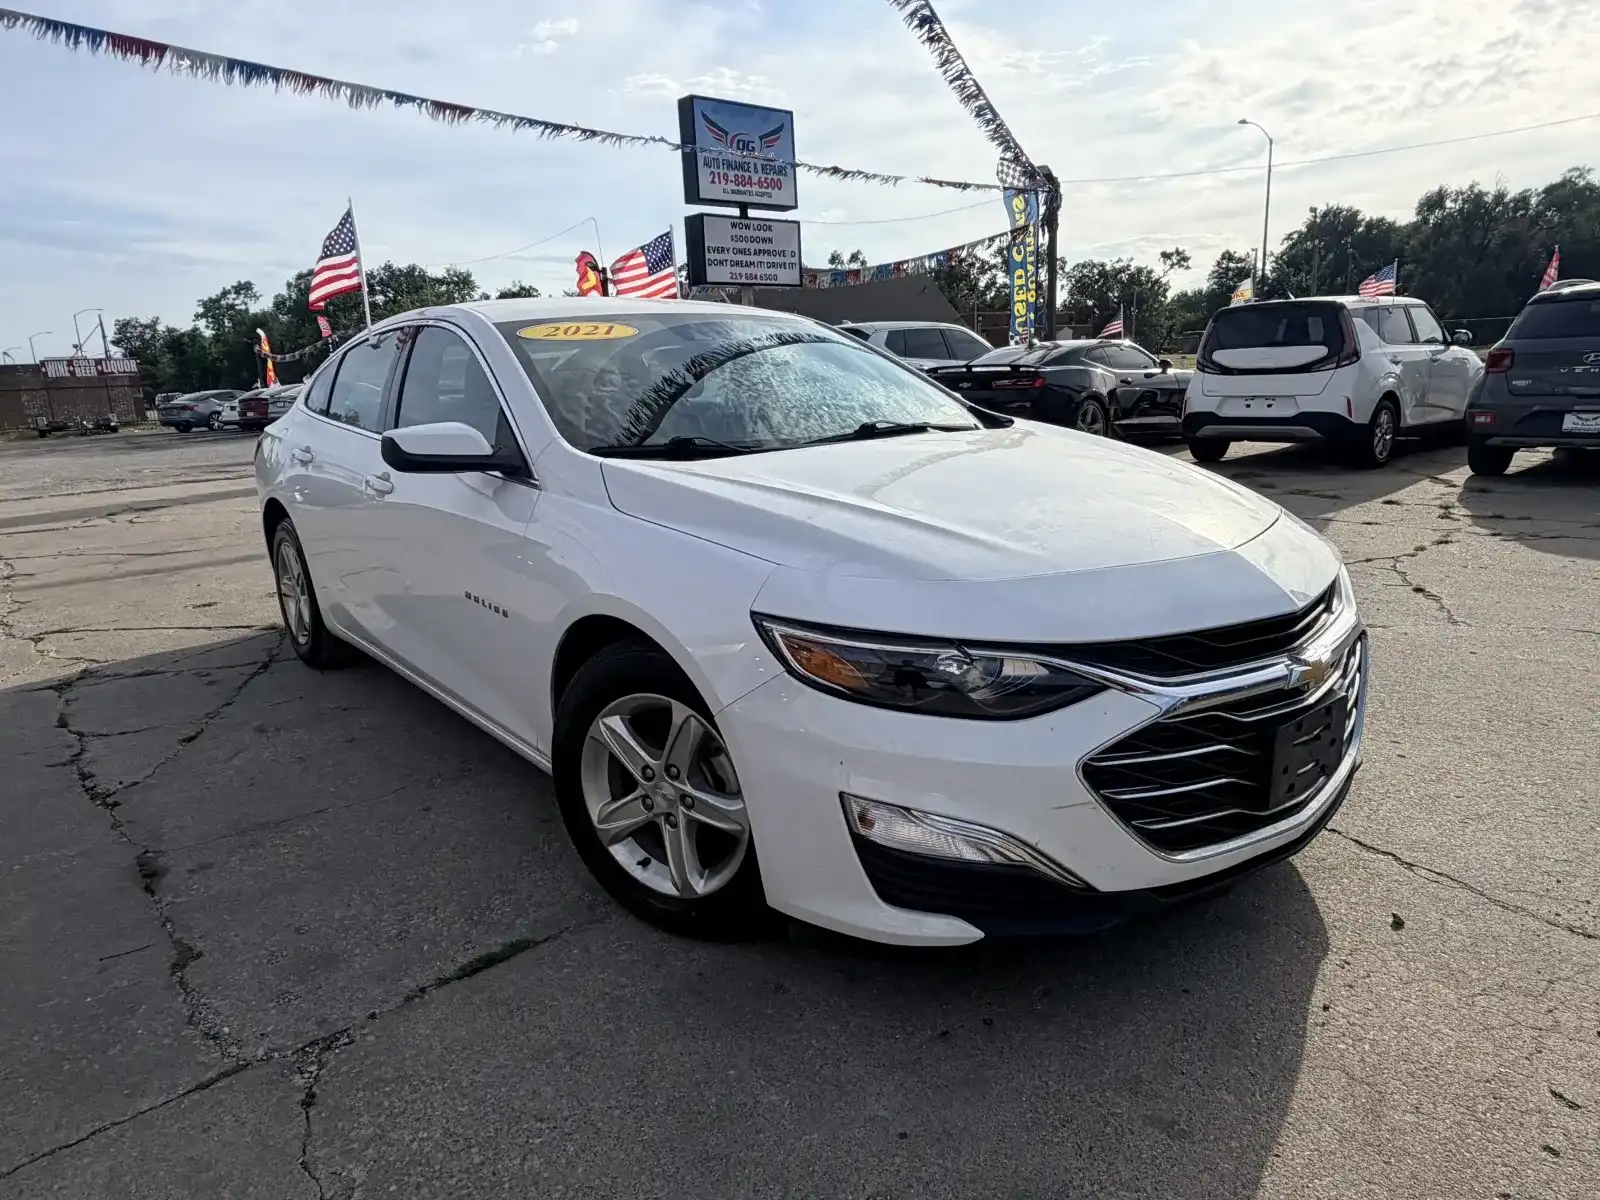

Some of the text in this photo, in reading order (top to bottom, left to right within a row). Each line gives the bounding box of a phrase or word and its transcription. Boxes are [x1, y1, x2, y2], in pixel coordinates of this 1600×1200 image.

[703, 155, 788, 177] AUTO FINANCE & REPAIRS
[709, 171, 783, 191] 219-884-6500
[730, 221, 773, 232] WOW LOOK
[730, 234, 773, 244] $500 DOWN
[707, 245, 731, 254] EVERY
[732, 247, 752, 256] ONES
[707, 258, 796, 270] DONT DREAM IT! DRIVE IT!
[729, 272, 778, 282] 219 884 6500
[543, 325, 615, 338] 2021
[73, 359, 96, 367] COLD
[101, 359, 138, 374] LIQUOR
[45, 360, 70, 378] WINE
[75, 366, 97, 377] BEER
